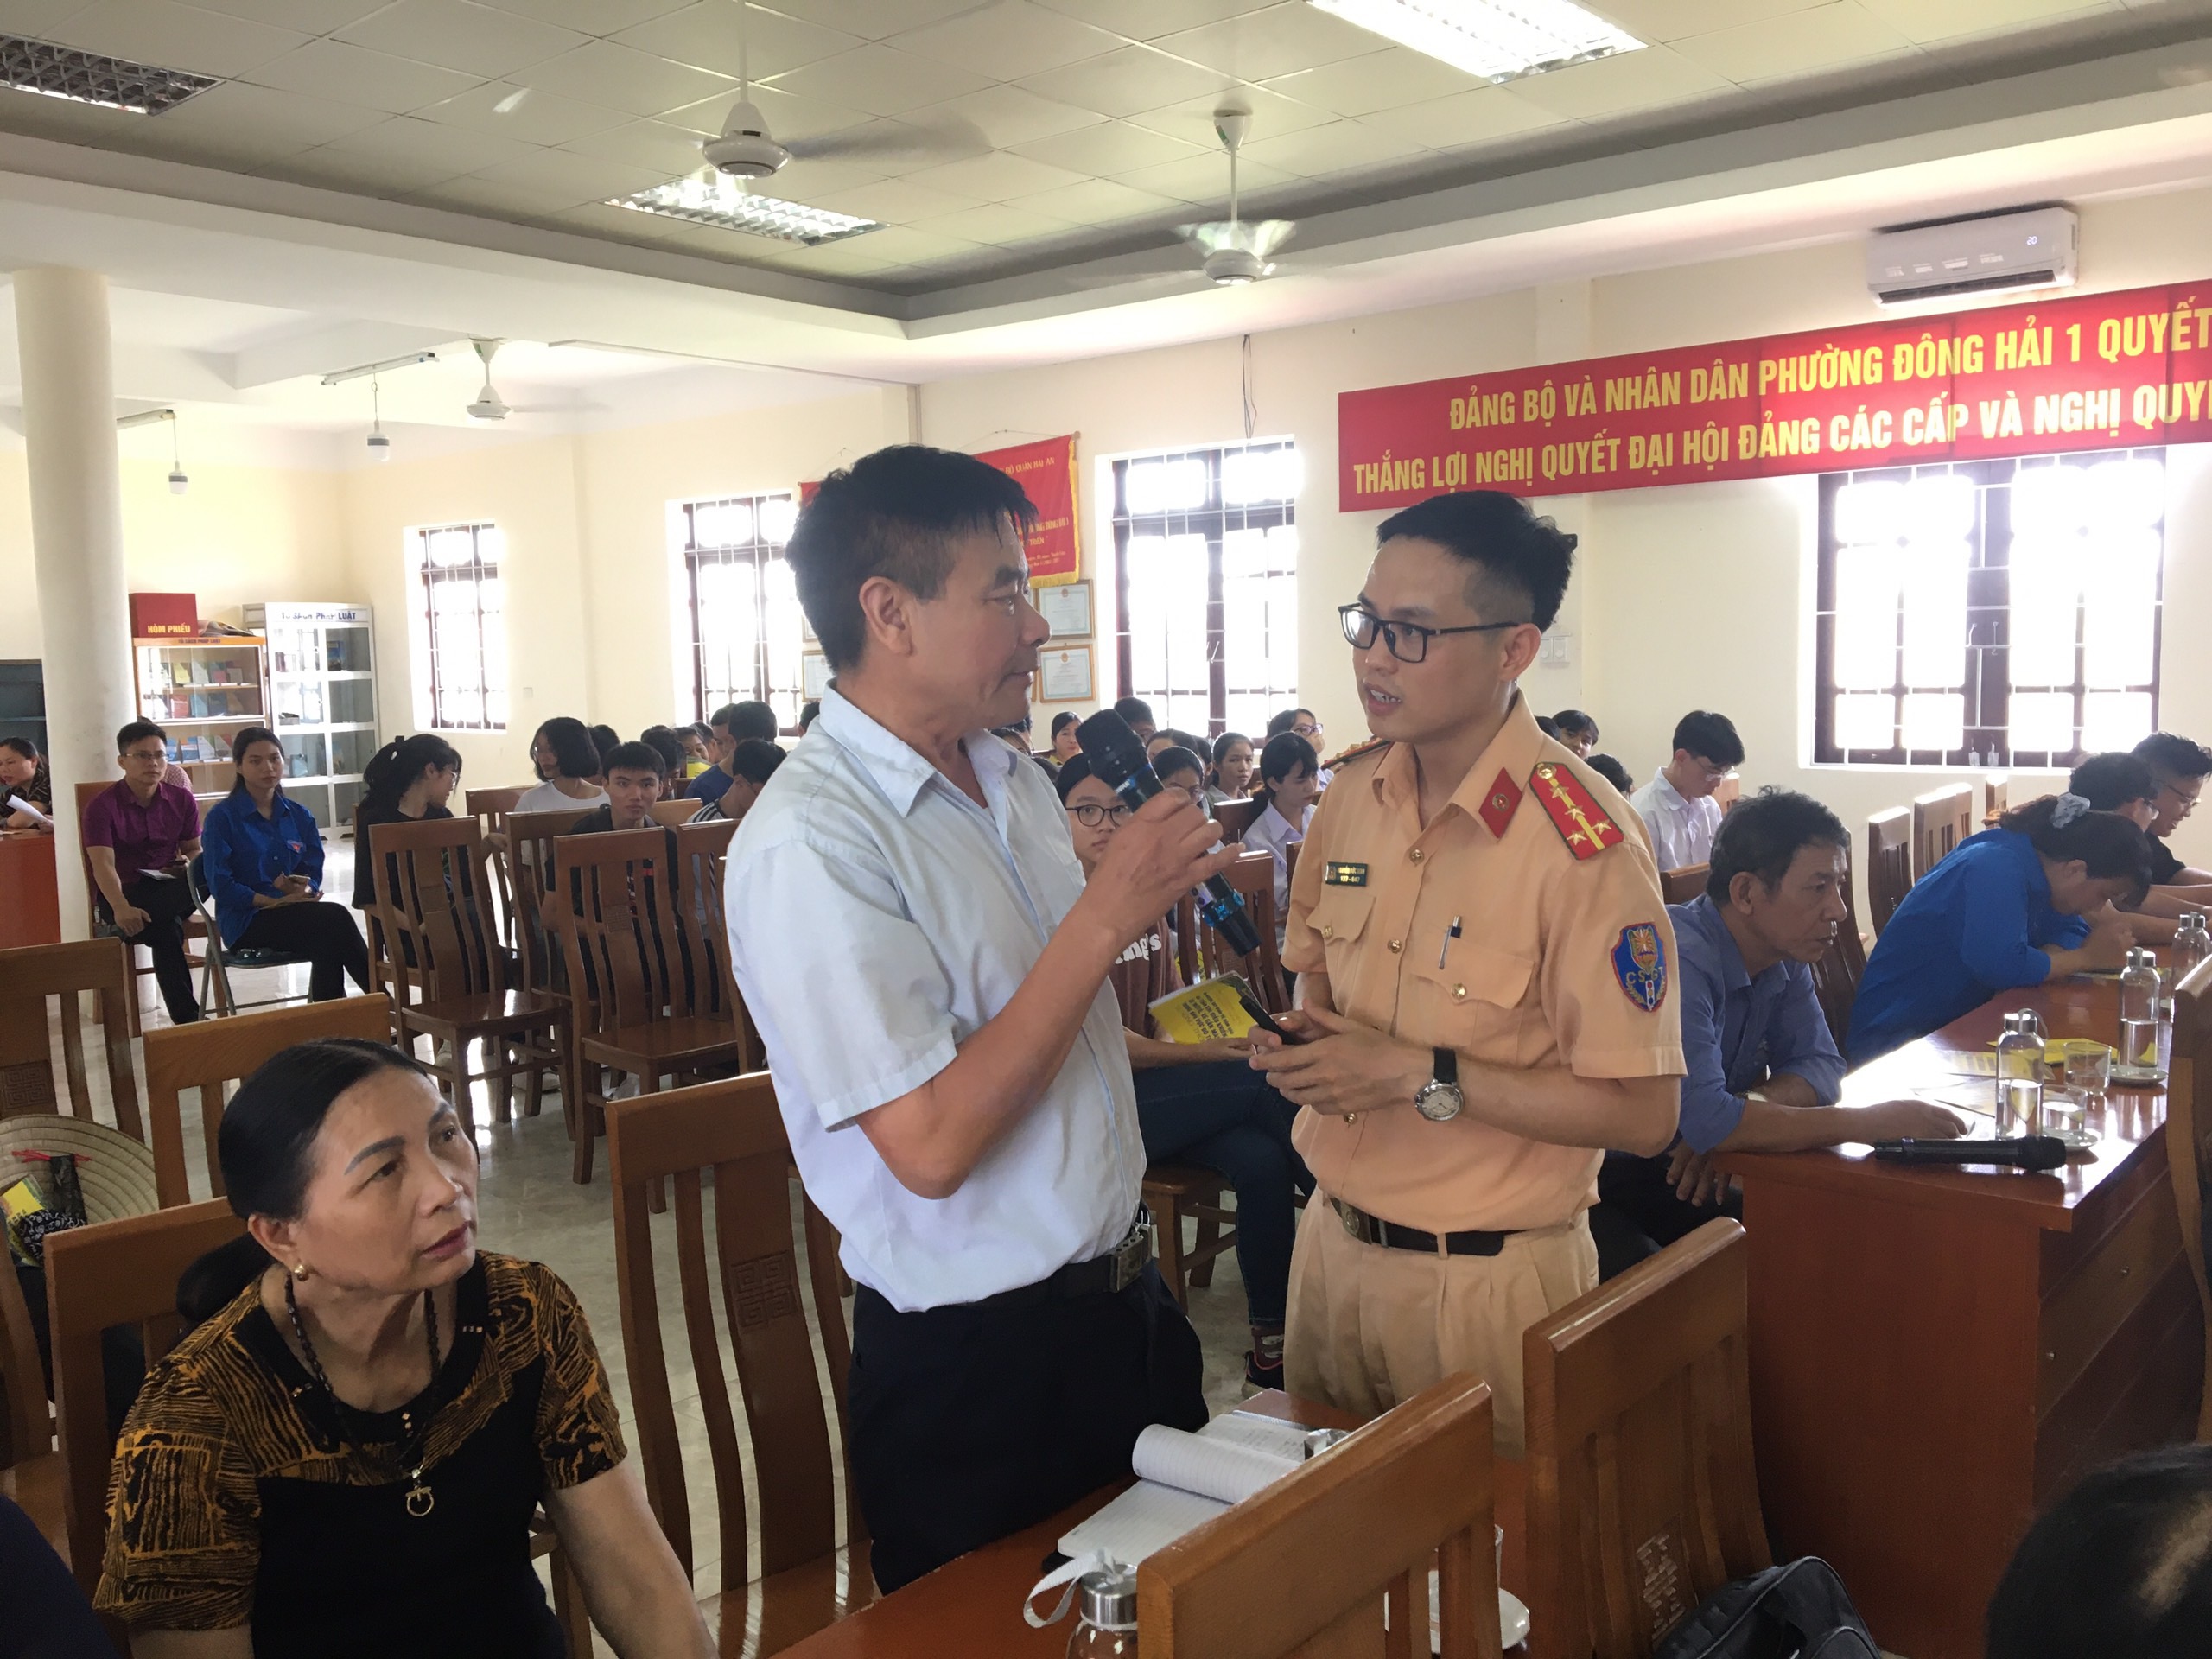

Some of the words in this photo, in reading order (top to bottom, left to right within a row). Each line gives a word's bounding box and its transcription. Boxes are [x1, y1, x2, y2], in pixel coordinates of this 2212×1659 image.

[1449, 385, 1516, 430] ĐẢNG
[1523, 379, 1556, 428] BỘ
[1565, 374, 1598, 417] VÀ
[1605, 366, 1681, 412] NHÂN
[1690, 358, 1749, 404] DÂN
[1759, 343, 1883, 396] PHƯỜNG
[1892, 333, 1984, 382] ĐÔNG
[1995, 315, 2053, 371] HẢI
[2066, 323, 2082, 363] 1
[2098, 296, 2212, 363] QUYẾT
[1353, 449, 1426, 495] THẮNG
[1432, 450, 1468, 493] LỢI
[1475, 446, 1534, 487] NGHỊ
[1541, 428, 1622, 481] QUYẾT
[1628, 432, 1674, 476] ĐẠI
[1682, 421, 1729, 471] HỘI
[1738, 410, 1820, 460] ĐẢNG
[1829, 404, 1893, 452] CÁC
[1901, 391, 1969, 447] CẤP
[1979, 390, 2024, 439] VÀ
[2033, 388, 2121, 437] NGHỊ
[2132, 379, 2212, 430] QUY
[147, 623, 166, 633] HÒM
[168, 622, 191, 633] PHIẾU
[338, 610, 356, 621] LUẬT
